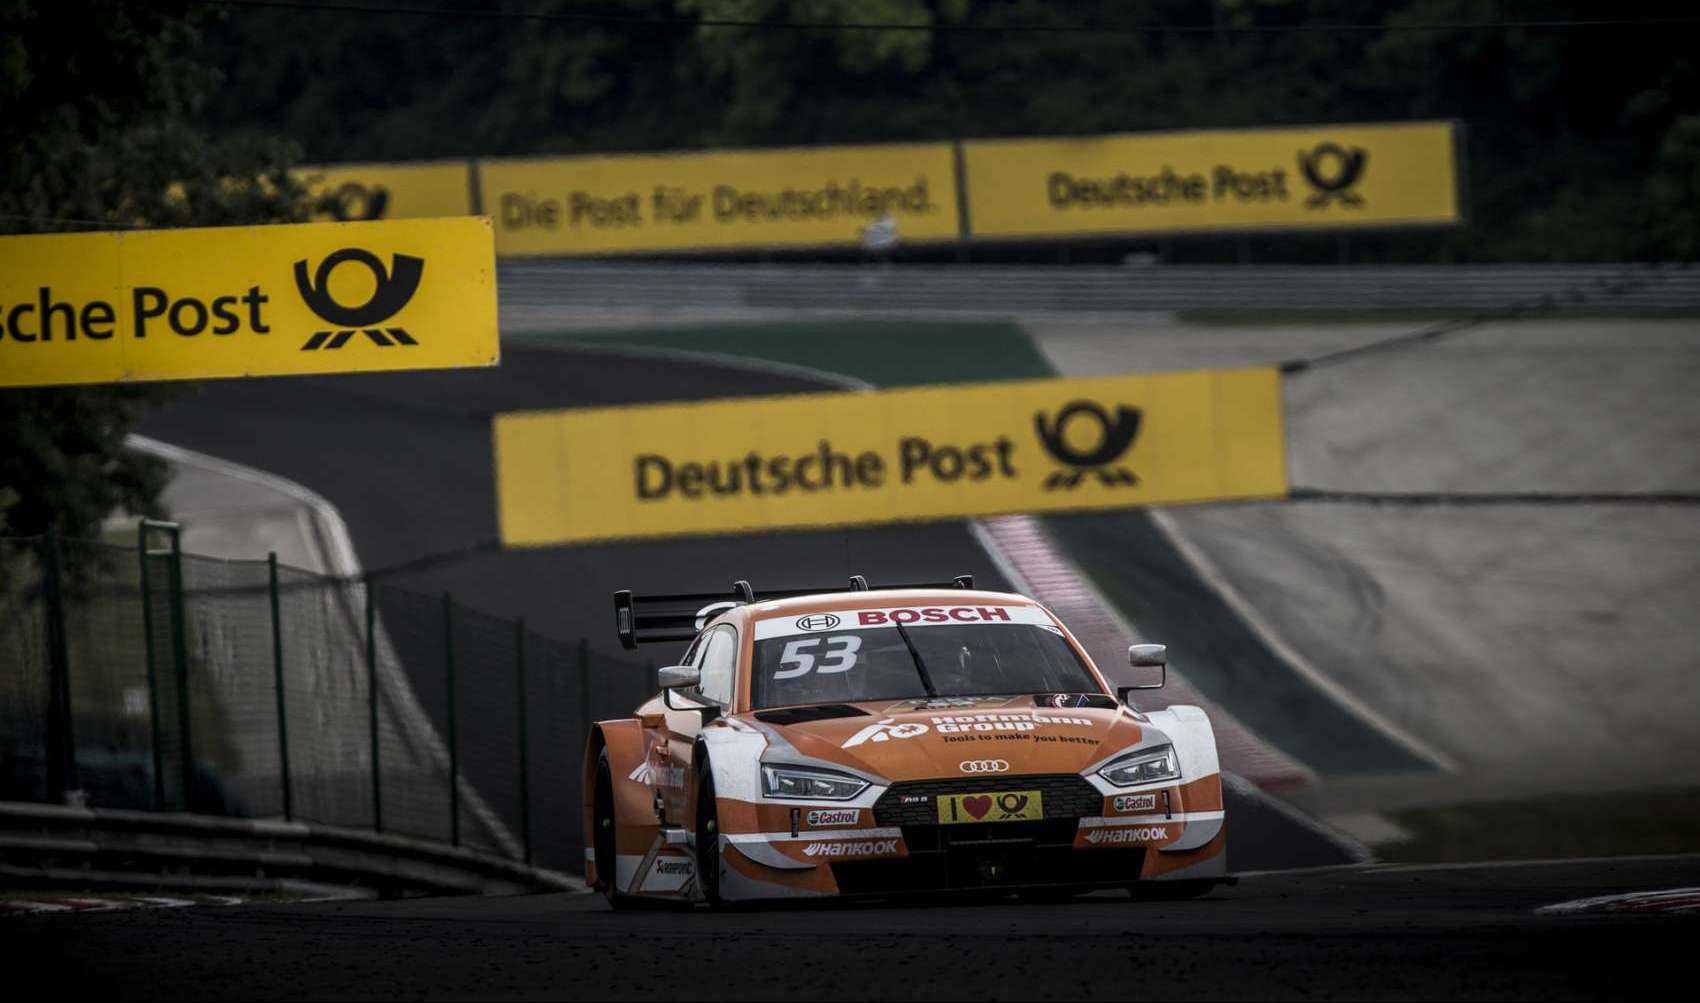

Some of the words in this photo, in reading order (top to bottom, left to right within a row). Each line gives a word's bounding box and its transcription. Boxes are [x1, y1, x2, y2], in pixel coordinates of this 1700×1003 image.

[1048, 164, 1208, 208] Deutsche
[1212, 164, 1289, 201] Post
[501, 189, 560, 230] Die
[568, 190, 642, 227] Post
[652, 183, 703, 222] für
[0, 287, 117, 343] che
[132, 286, 271, 338] Post
[634, 439, 886, 500] Deutsche
[899, 436, 1017, 485] Post
[857, 607, 1012, 626] BOSCH
[773, 635, 863, 680] 53
[935, 721, 1036, 734] Group
[942, 733, 977, 744] Tools
[978, 734, 993, 743] to
[995, 733, 1031, 742] make
[1033, 735, 1057, 743] you
[1058, 734, 1101, 746] better
[951, 797, 957, 820] I
[1124, 796, 1154, 809] Castrol
[819, 810, 856, 824] Castrol
